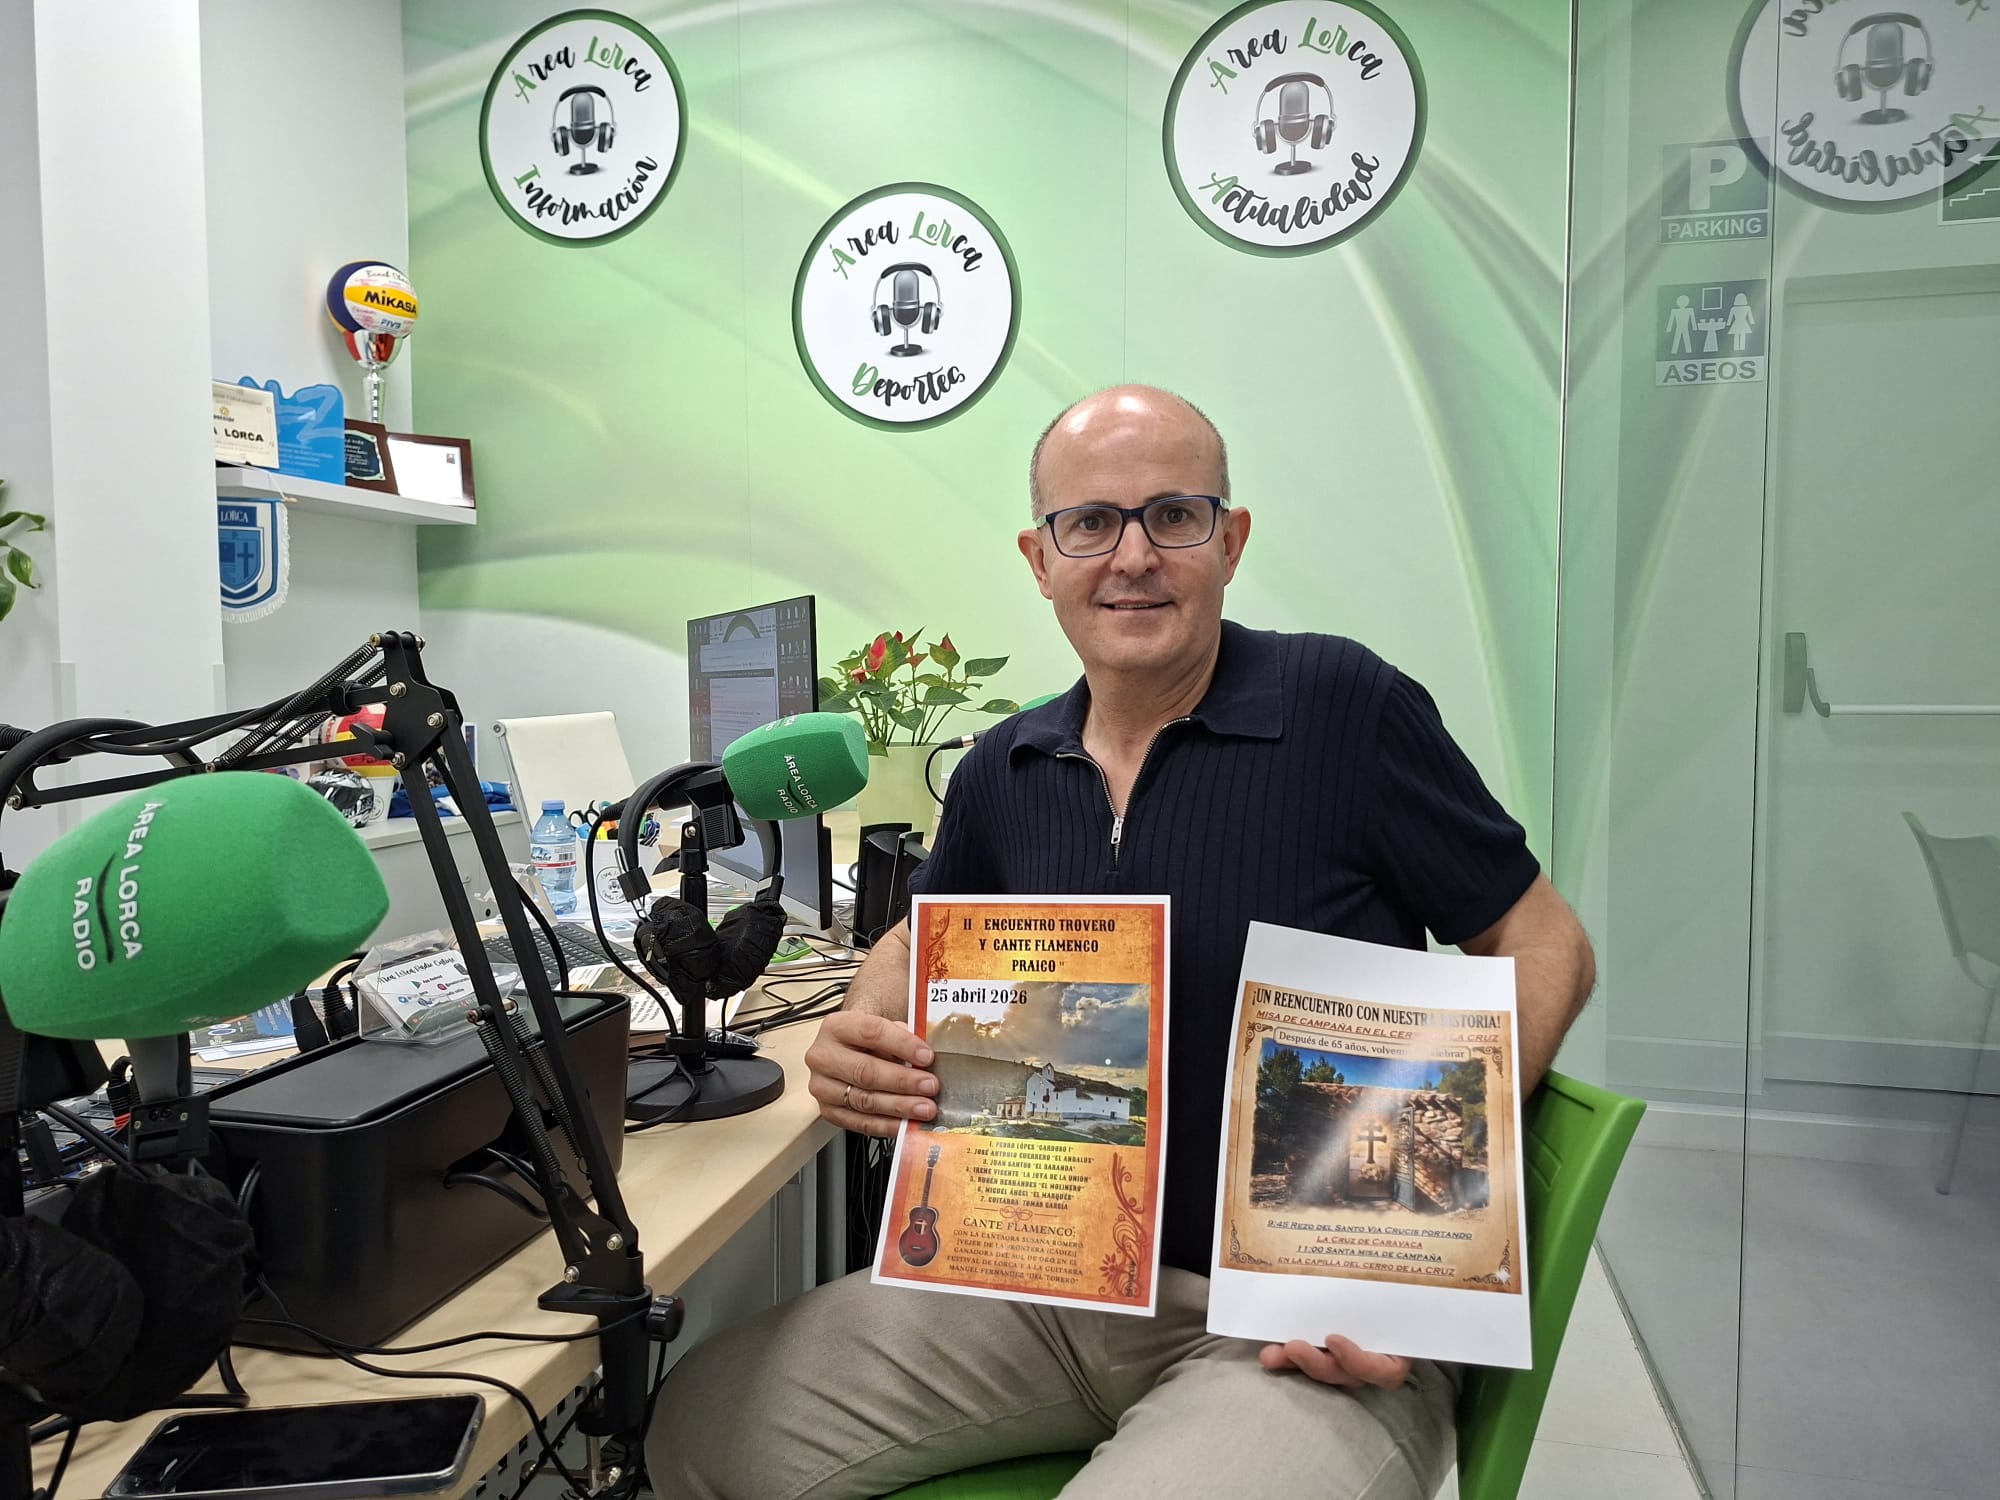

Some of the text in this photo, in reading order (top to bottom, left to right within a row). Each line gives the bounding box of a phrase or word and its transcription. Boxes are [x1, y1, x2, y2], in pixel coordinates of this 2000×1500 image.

[1297, 17, 1384, 81] Lorca
[584, 36, 652, 92] Lorca
[513, 156, 658, 226] Información
[1198, 152, 1380, 234] Actualidad
[1667, 217, 1762, 240] PARKING
[908, 211, 983, 272] Lorca
[1662, 360, 1757, 384] ASEOS
[852, 362, 966, 407] Deportes
[224, 428, 265, 443] LORCA
[220, 509, 249, 524] LORCA
[784, 753, 818, 809] ÁREA LORCA
[777, 788, 799, 814] RADIO
[118, 865, 145, 960] LORCA
[73, 876, 96, 971] RADIO
[963, 918, 1116, 932] II ENCUENTRO TROVERO
[979, 938, 1099, 953] Y CANTE FLAMENCO
[931, 987, 1028, 1005] 25 abril 2026
[1252, 988, 1272, 1006] ¡UN
[1273, 991, 1353, 1018] REENCUENTRO
[1356, 1005, 1380, 1022] CON
[1256, 1010, 1280, 1021] MISA
[1283, 1014, 1298, 1024] DE
[1299, 1017, 1352, 1033] CAMPAÑA
[1355, 1026, 1371, 1035] EN
[1373, 1028, 1387, 1038] EL
[1466, 1033, 1499, 1043] CRUZ
[1279, 1031, 1316, 1046] Después
[1318, 1037, 1329, 1047] de
[1331, 1039, 1343, 1049] 65
[1344, 1042, 1369, 1053] años,
[989, 1159, 1006, 1167] JUAN
[990, 1150, 1018, 1159] ANTONIO
[1050, 1173, 1058, 1181] DE
[953, 1229, 968, 1237] CON
[970, 1230, 979, 1238] LA
[963, 1217, 1003, 1230] CANTE
[1267, 1219, 1289, 1229] 9:45
[1420, 1229, 1473, 1240] PORTANDO
[1358, 1238, 1371, 1246] DE
[946, 1255, 980, 1265] FESTIVAL
[994, 1260, 1017, 1268] LORCA
[1045, 1265, 1083, 1276] GUITARRA
[995, 1251, 1009, 1259] DEL
[1039, 1256, 1055, 1264] ORO
[1358, 1248, 1379, 1257] MISA
[1381, 1250, 1394, 1258] DE
[1396, 1251, 1442, 1263] CAMPAÑA
[949, 1263, 978, 1273] MANUEL
[1291, 1257, 1302, 1265] LA
[1304, 1258, 1341, 1268] CAPILLA
[1343, 1260, 1359, 1269] DEL
[1362, 1262, 1394, 1272] CERRO
[1396, 1265, 1409, 1273] DE
[1411, 1266, 1422, 1274] LA
[1425, 1266, 1456, 1277] CRUZ
